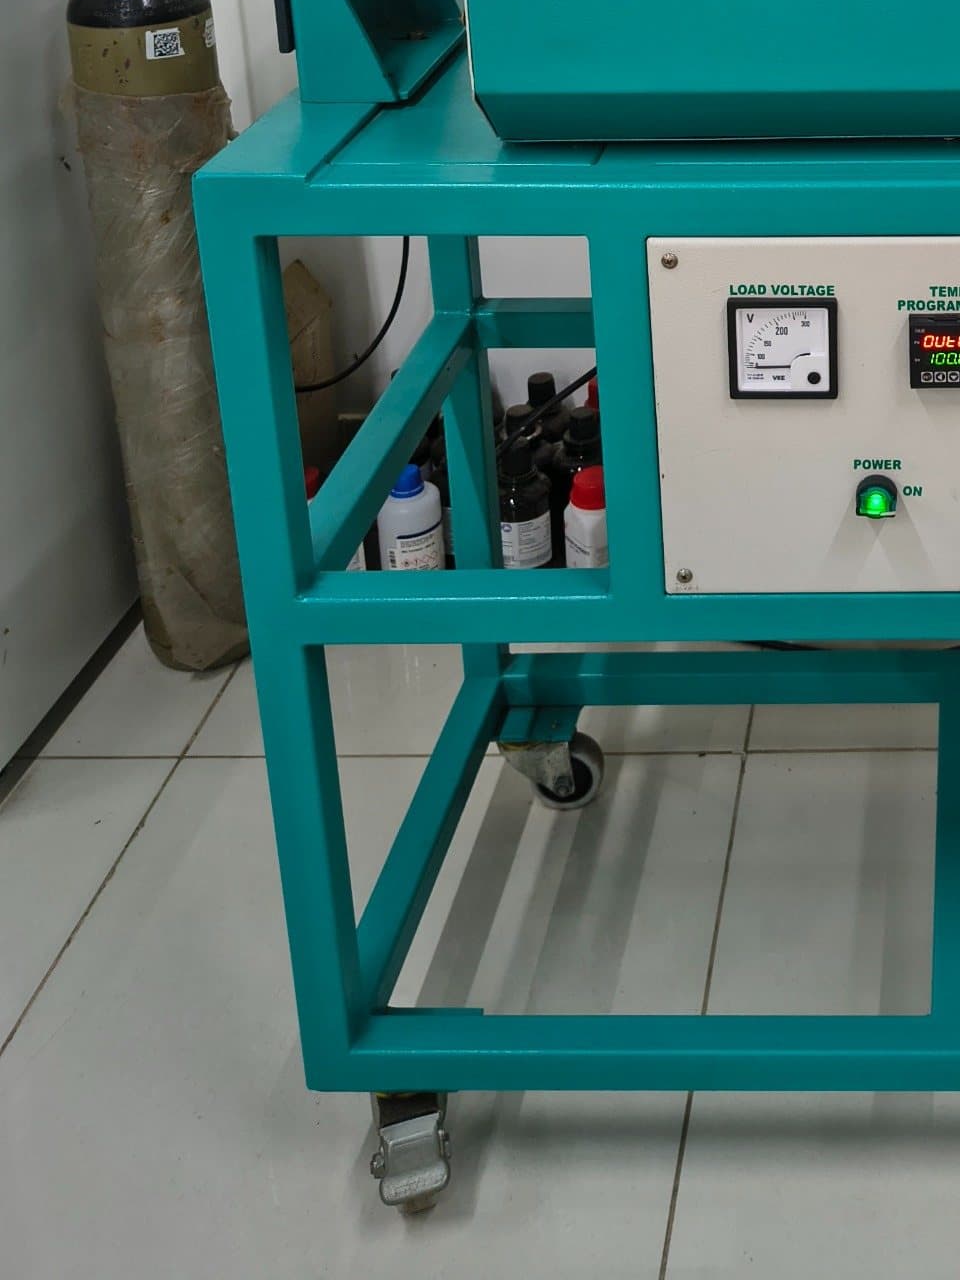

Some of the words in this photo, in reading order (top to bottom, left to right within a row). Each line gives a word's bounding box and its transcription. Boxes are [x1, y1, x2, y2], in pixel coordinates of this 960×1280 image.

[729, 284, 767, 296] LOAD
[770, 284, 835, 296] VOLTAGE
[746, 313, 754, 323] V
[775, 326, 788, 336] 200
[853, 459, 902, 470] POWER
[902, 485, 923, 497] ON
